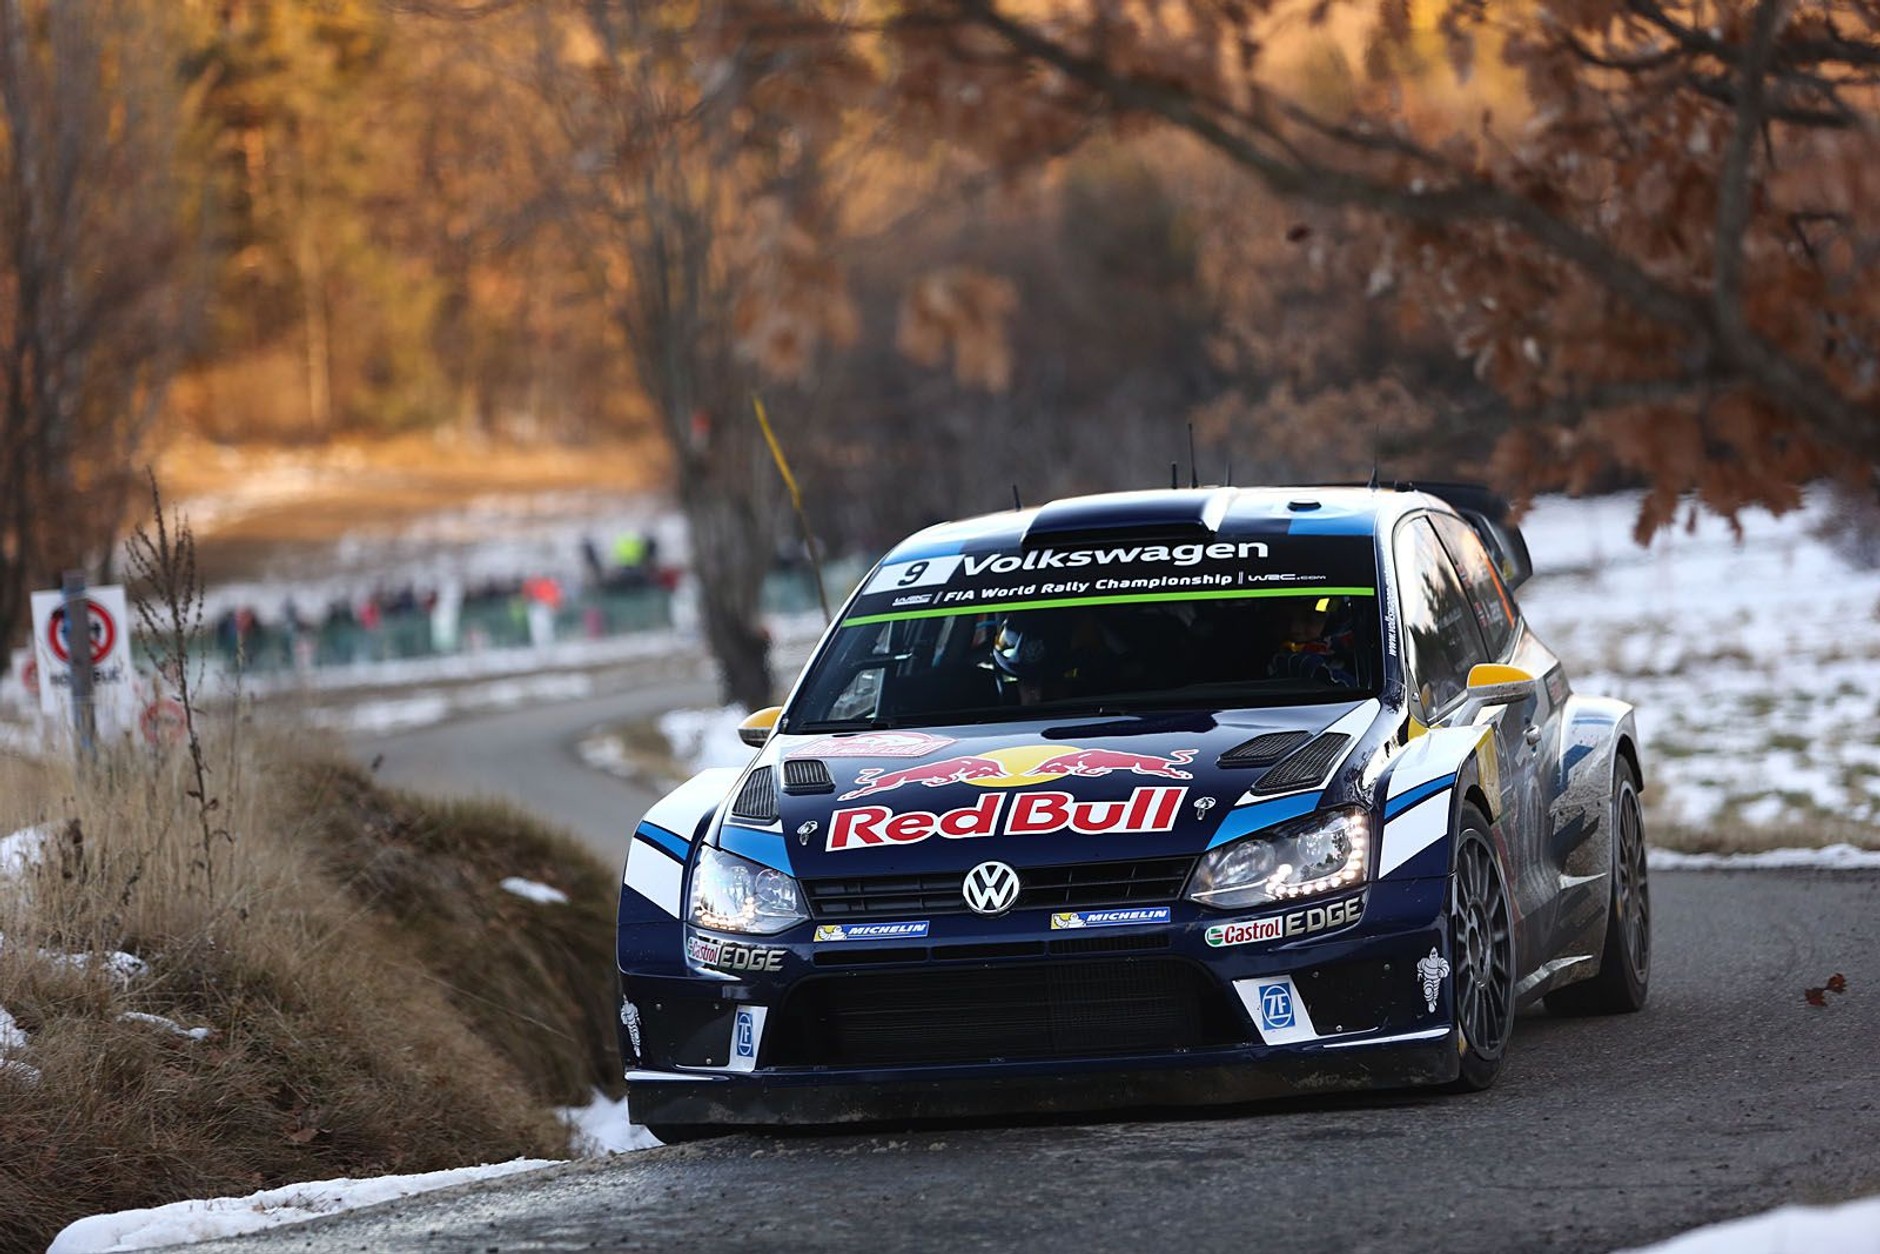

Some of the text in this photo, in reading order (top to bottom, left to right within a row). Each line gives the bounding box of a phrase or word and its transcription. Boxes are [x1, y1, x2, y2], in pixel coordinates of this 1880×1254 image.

[963, 541, 1269, 576] Volkswagen
[897, 561, 930, 587] 9
[943, 590, 975, 602] FIA
[981, 582, 1036, 599] World
[1040, 580, 1091, 595] Rally
[1095, 574, 1233, 589] Championship
[825, 786, 1190, 852] Red Bull
[848, 922, 927, 936] MICHELIN
[1086, 909, 1168, 922] MICHELIN
[1224, 897, 1362, 944] Castrol EDGE
[692, 940, 788, 971] Castrol EDGE
[1263, 991, 1294, 1020] ZF
